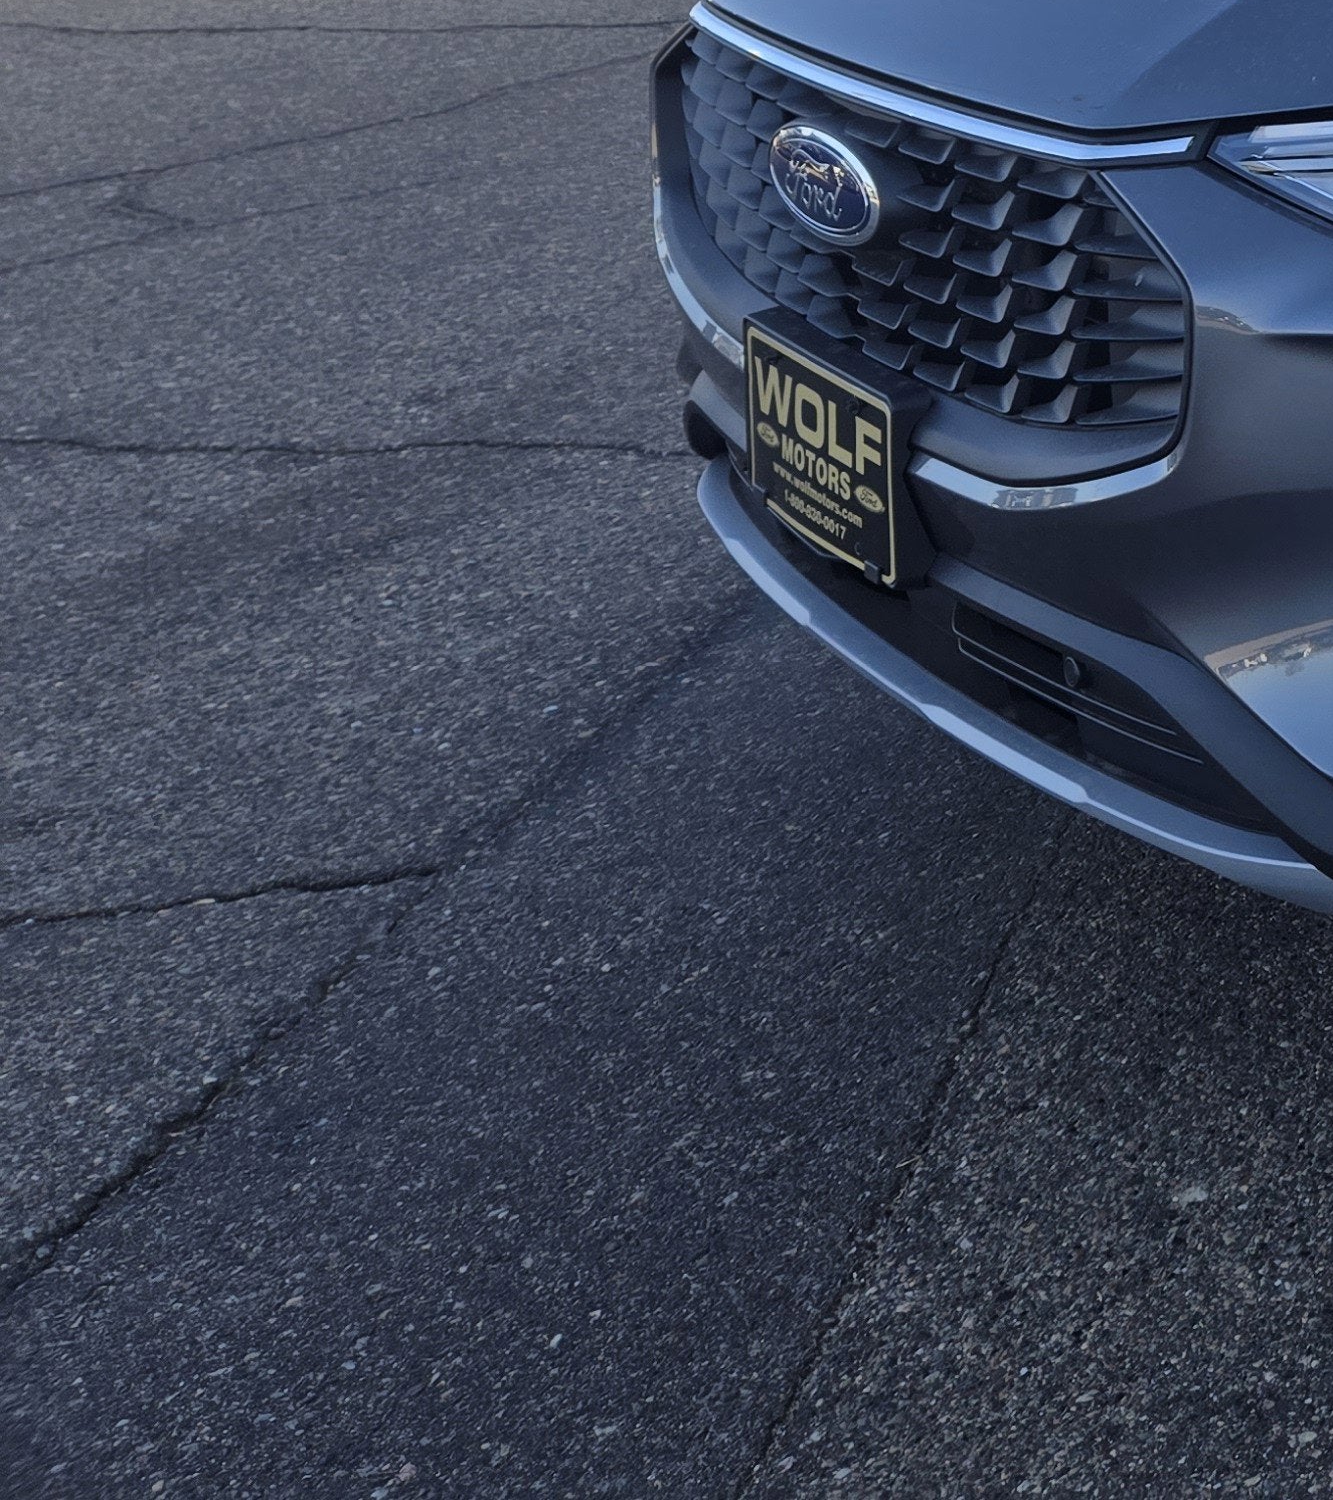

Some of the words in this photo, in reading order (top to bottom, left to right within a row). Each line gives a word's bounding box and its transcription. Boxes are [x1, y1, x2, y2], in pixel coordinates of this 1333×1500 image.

[784, 148, 845, 222] Ford
[754, 355, 882, 476] WOLF
[772, 461, 863, 529] www.wolfmotors.com
[781, 433, 851, 501] MOTORS
